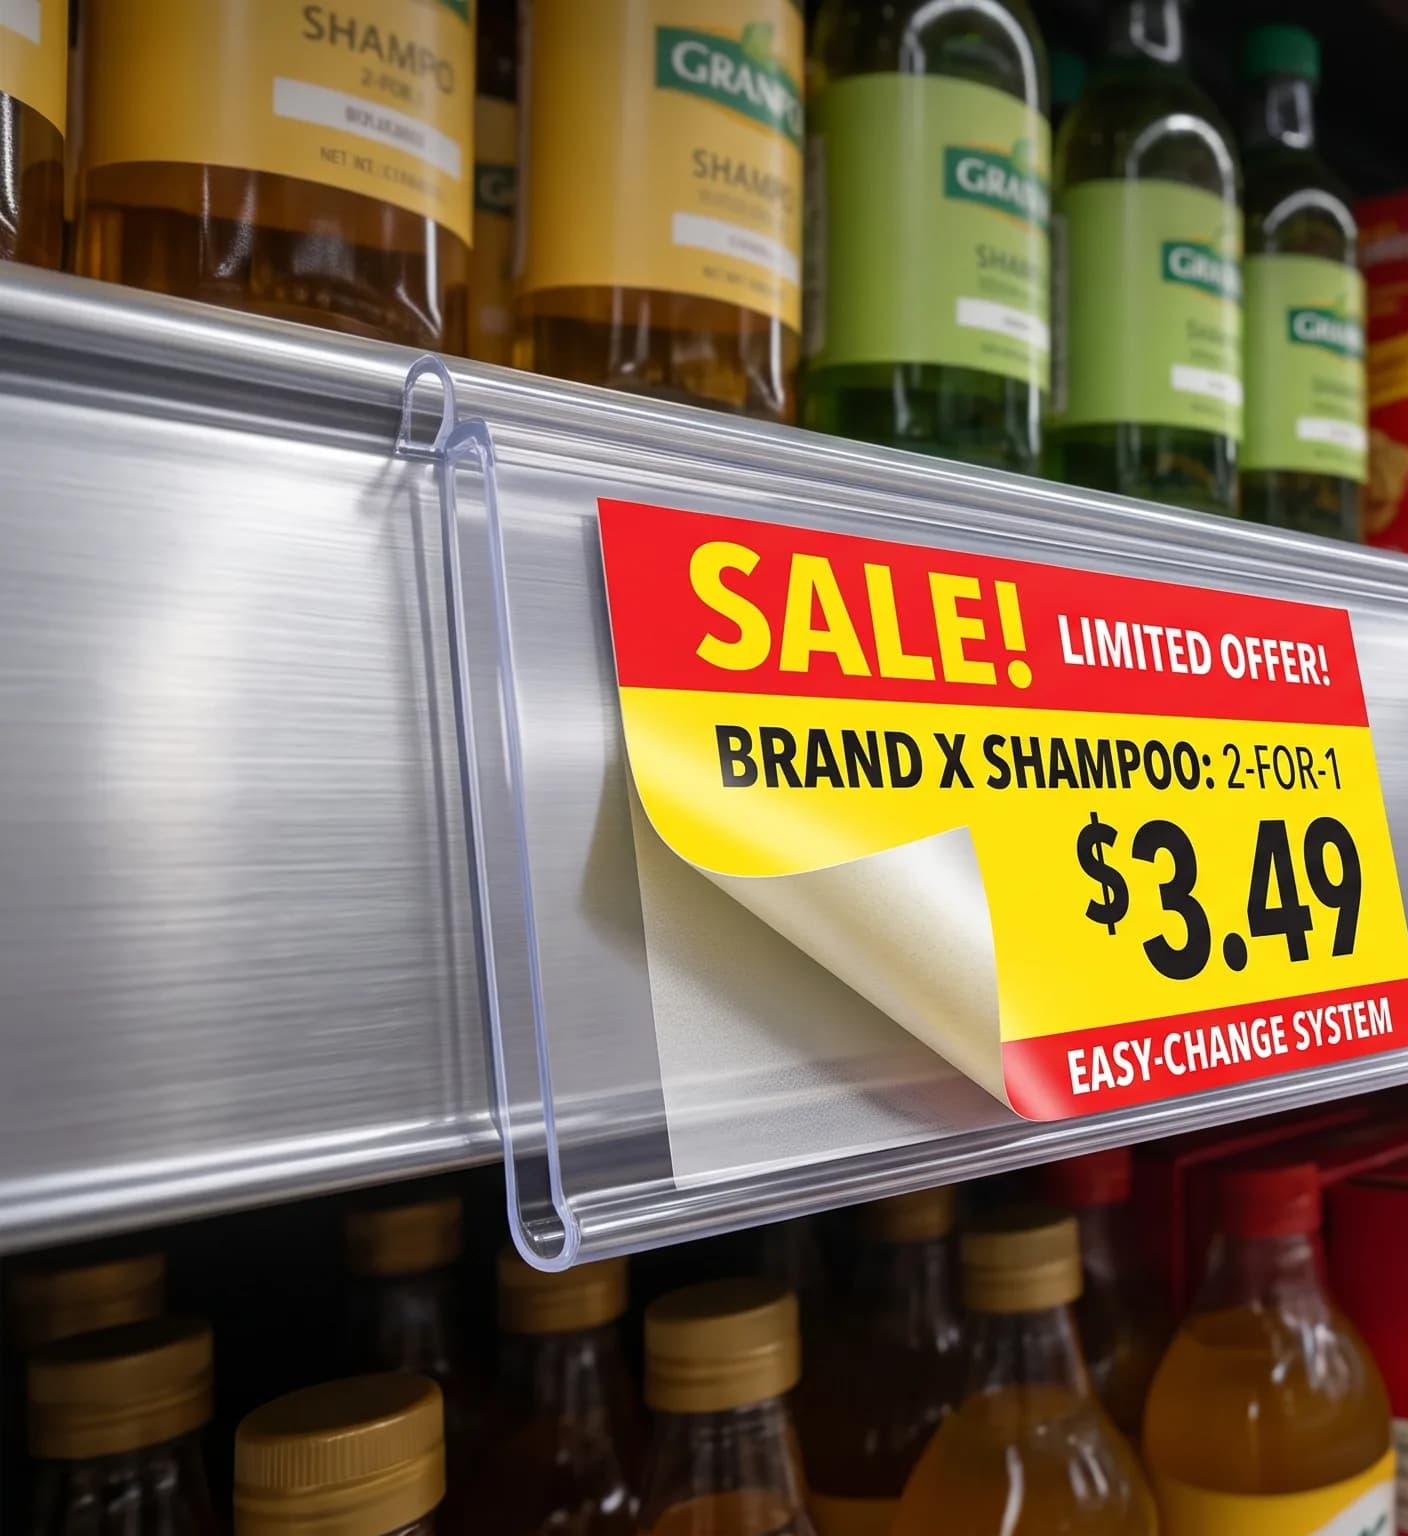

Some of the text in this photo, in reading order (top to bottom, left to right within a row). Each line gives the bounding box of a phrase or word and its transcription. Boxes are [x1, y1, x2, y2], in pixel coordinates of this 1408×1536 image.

[690, 542, 1332, 689] SALE! LIMITED OFFER!
[715, 724, 1342, 790] BRAND X SHAMPOO: 2-FOR-1
[1076, 811, 1363, 981] $3.49
[1067, 997, 1393, 1095] EASY-CHANGE SYSTEM
